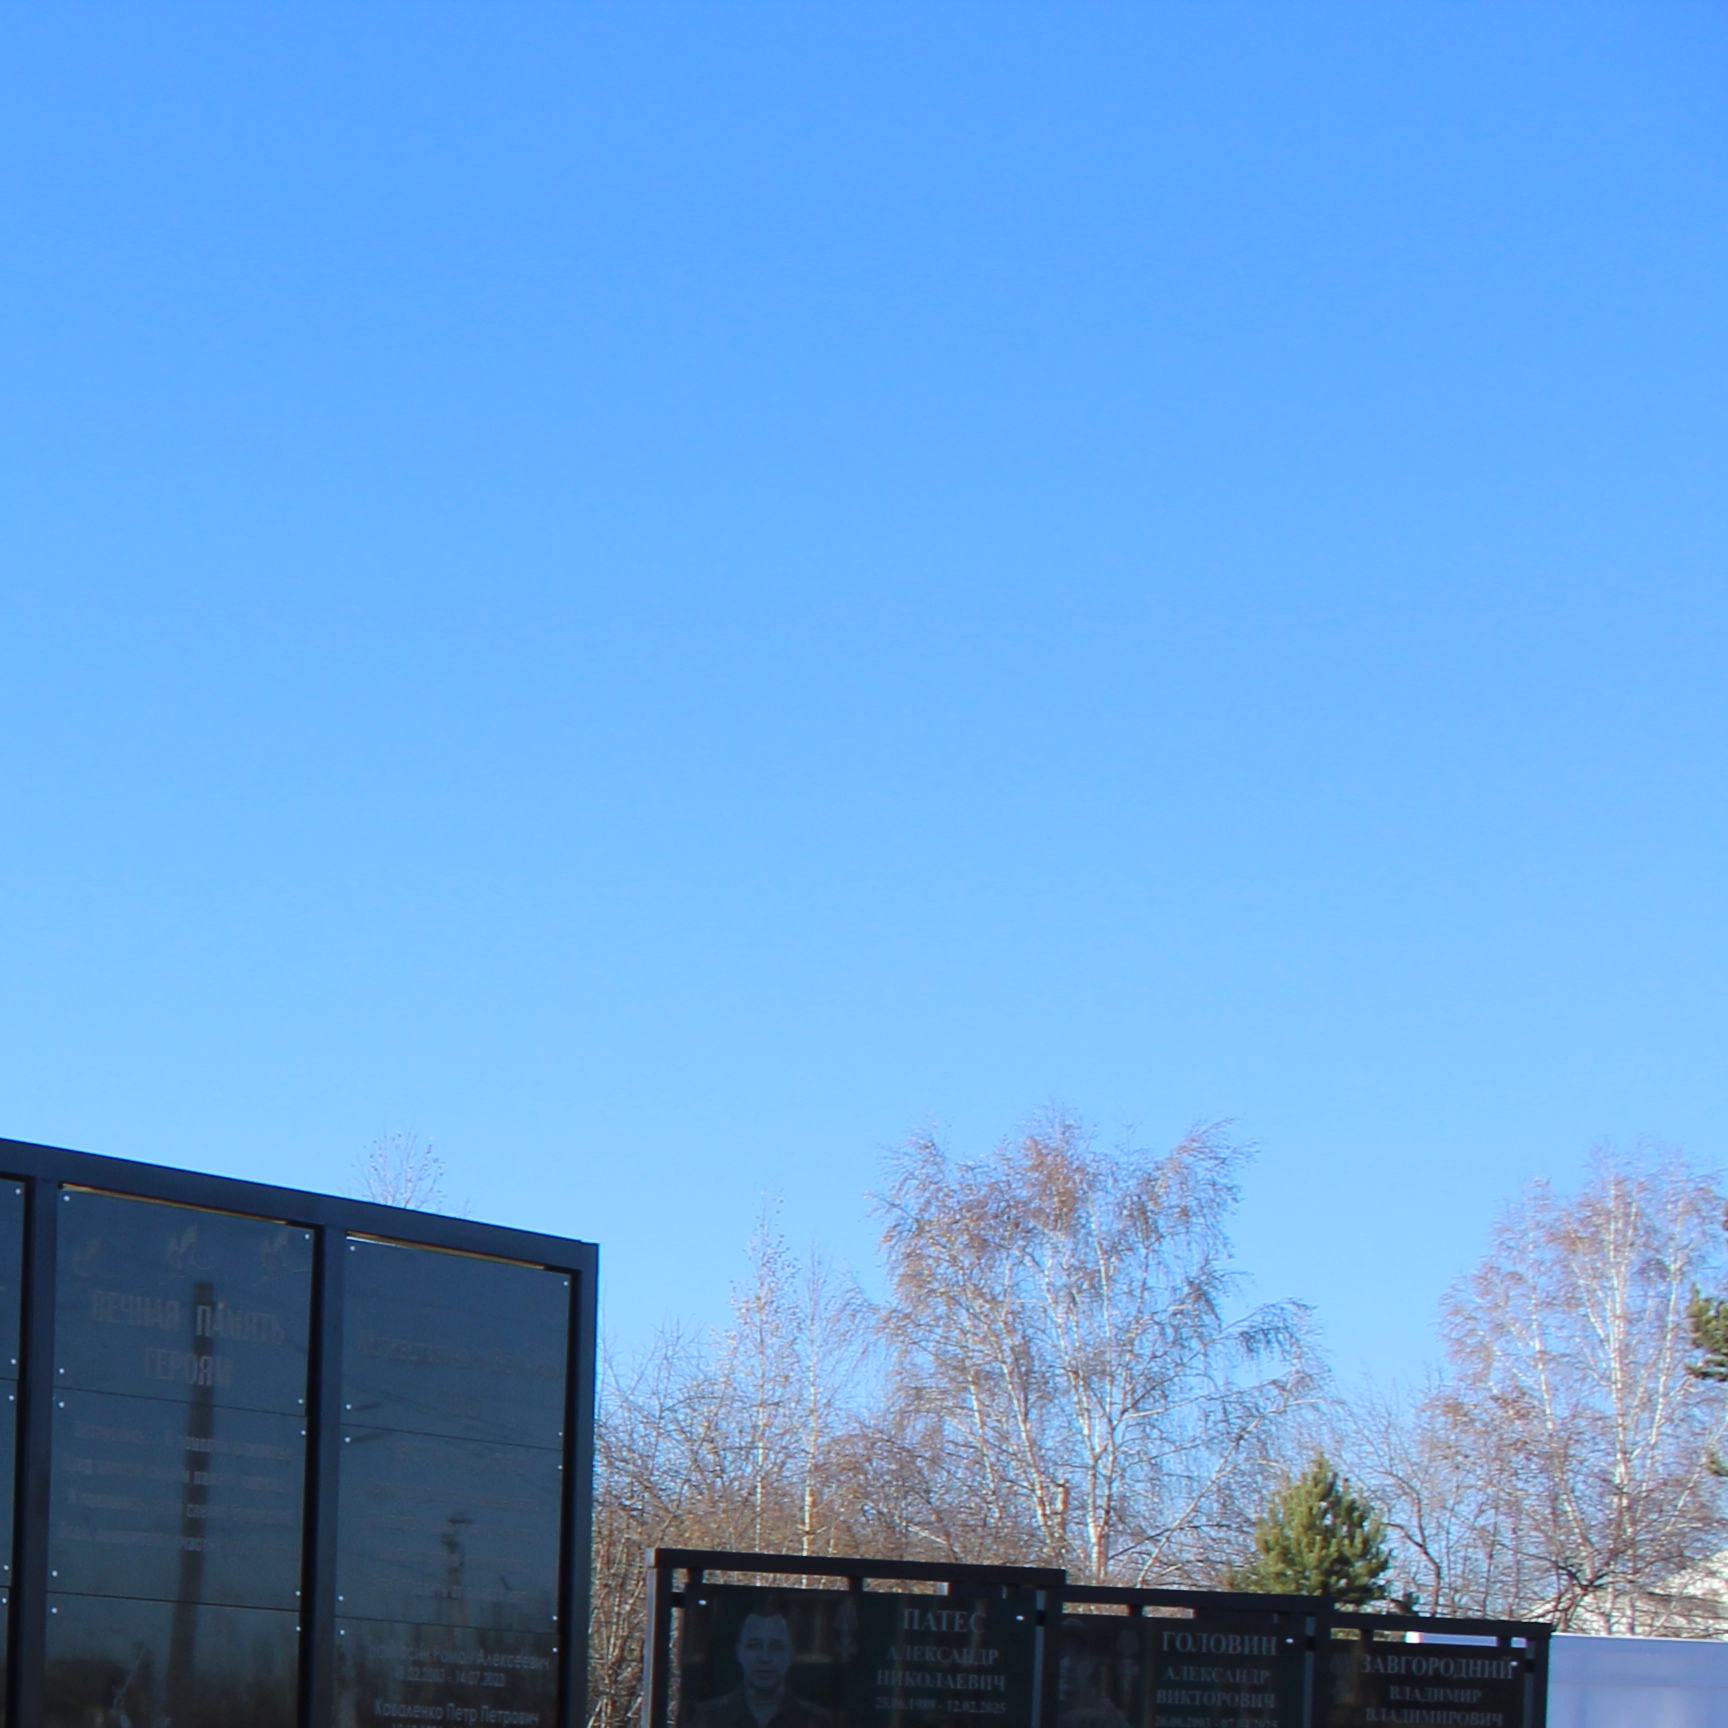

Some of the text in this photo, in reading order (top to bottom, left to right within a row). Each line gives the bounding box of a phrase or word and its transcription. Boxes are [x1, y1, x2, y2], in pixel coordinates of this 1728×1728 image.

[902, 1608, 988, 1634] ПАТЕС
[1162, 1631, 1278, 1656] ГОЛОВИН
[476, 1648, 550, 1670] Алексеевич
[885, 1645, 1000, 1666] АЛЕКСАНДР
[1360, 1653, 1514, 1680] ЗАВГОРОДНИЙ
[876, 1669, 1006, 1691] НИКОЛАЕВИЧ
[1163, 1665, 1271, 1685] АЛЕКСАНДР
[1155, 1688, 1276, 1709] ВИКТОРОВИЧ
[1389, 1685, 1483, 1704] ВЛАДИМИР
[374, 1699, 540, 1727] Коваленко Петр Петрович
[1365, 1707, 1504, 1728] ВЛАДИМИРОВИЧ
